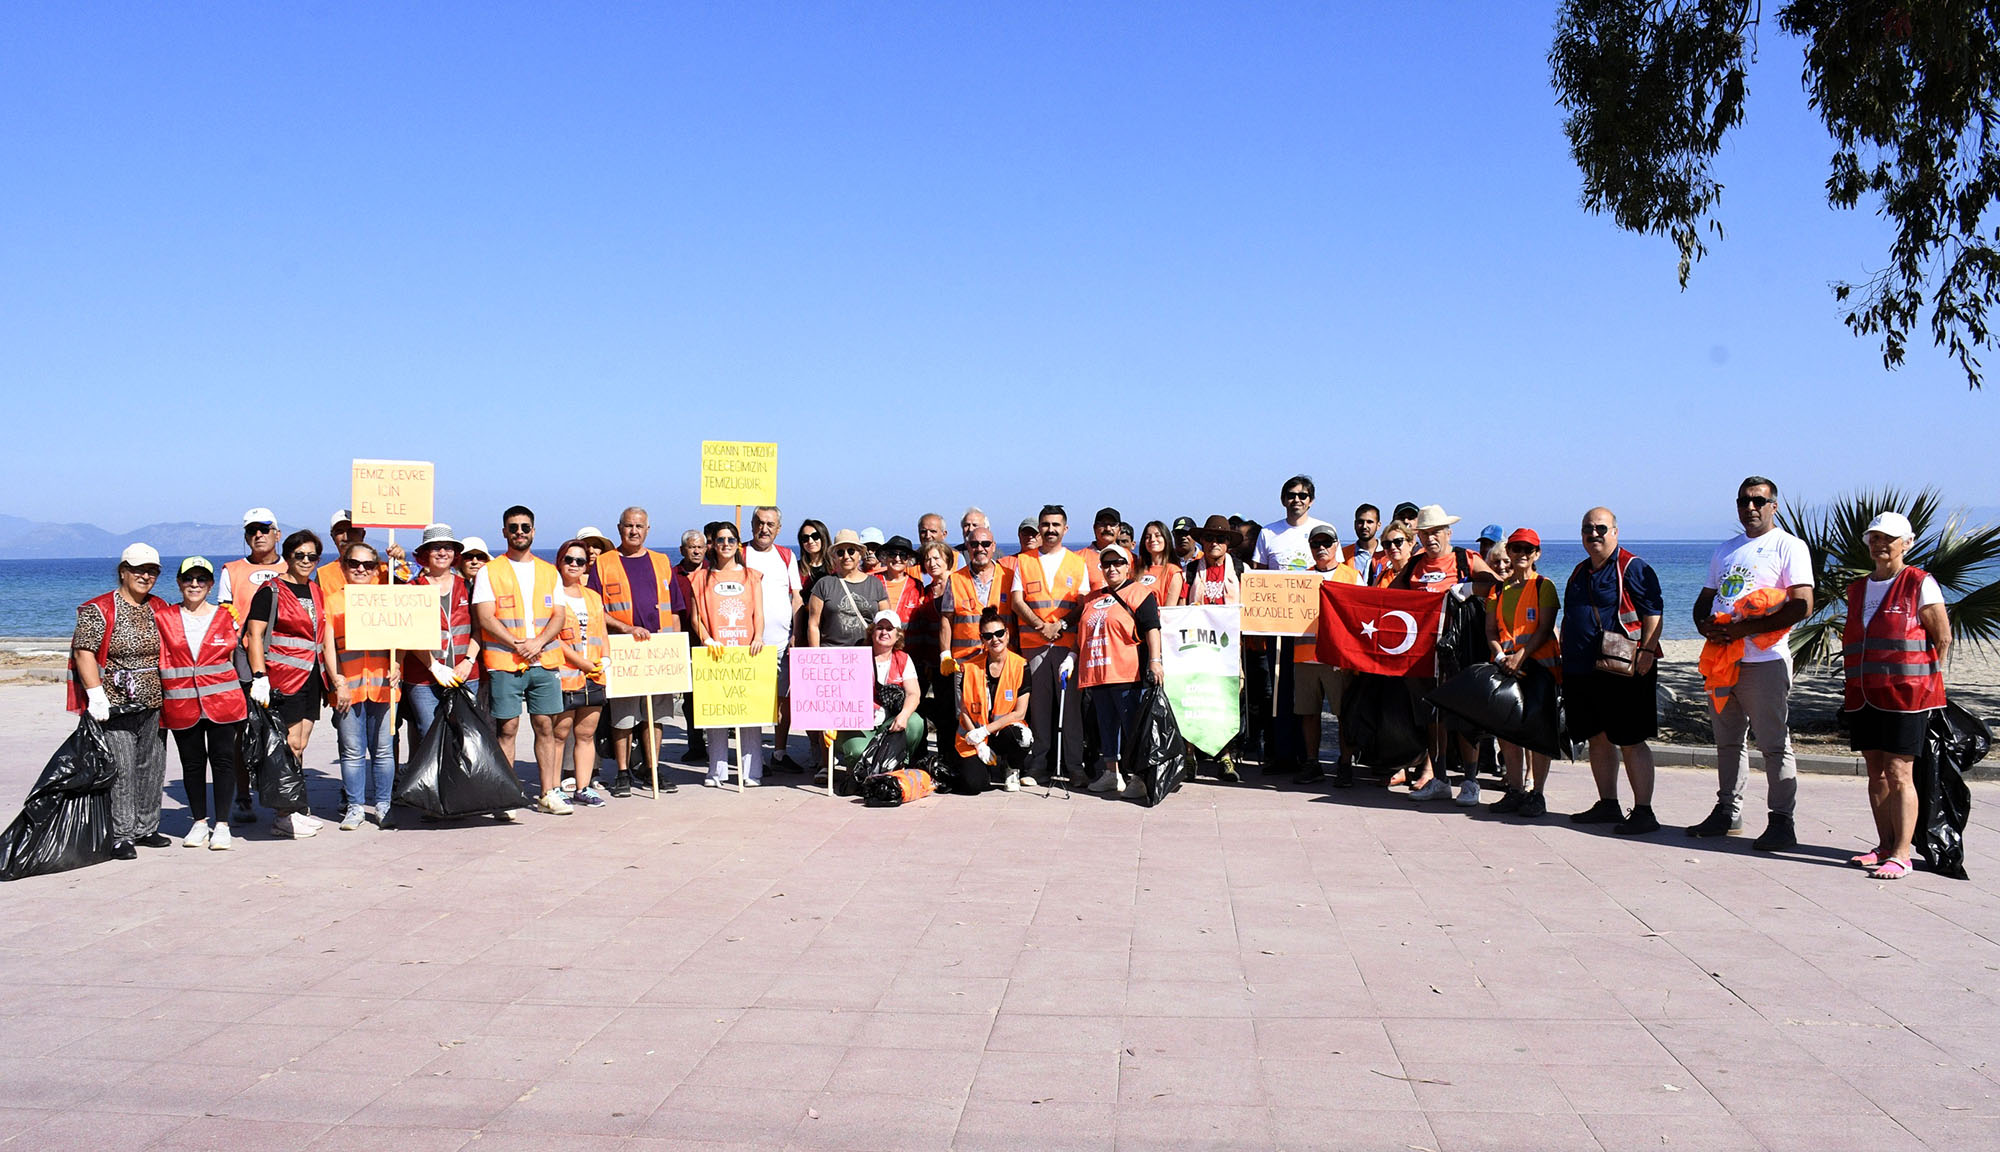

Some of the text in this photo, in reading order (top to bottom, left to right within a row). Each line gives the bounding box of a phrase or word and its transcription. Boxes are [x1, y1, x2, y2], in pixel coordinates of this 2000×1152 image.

[361, 501, 407, 516] EL ELE
[801, 667, 856, 681] GELECEK
[722, 685, 748, 698] VAR
